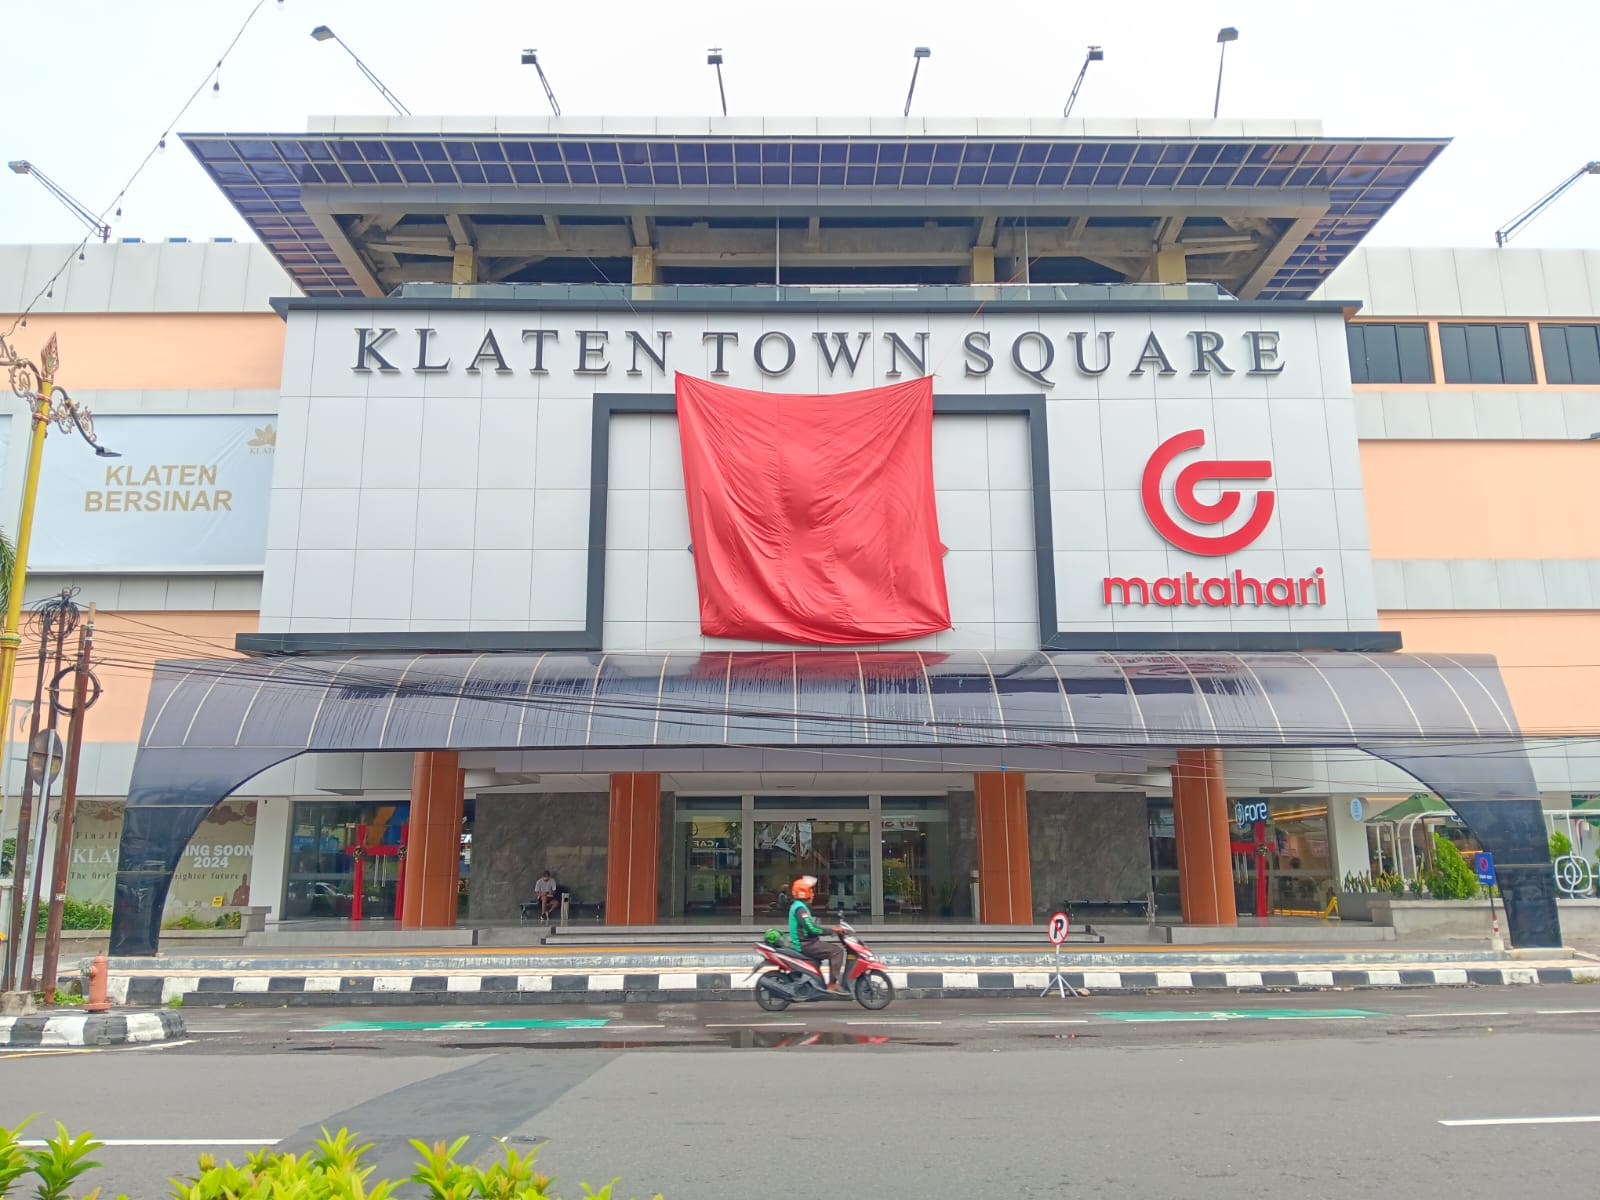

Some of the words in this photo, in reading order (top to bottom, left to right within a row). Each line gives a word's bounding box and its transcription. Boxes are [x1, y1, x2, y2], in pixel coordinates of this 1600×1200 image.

[351, 327, 673, 376] KLATEN
[702, 330, 931, 377] TOWN
[963, 329, 1287, 388] SQUARE
[104, 464, 218, 486] KLATEN
[84, 490, 233, 512] BERSINAR
[1102, 566, 1327, 607] matahari
[213, 844, 255, 857] SOON
[192, 856, 230, 868] 2024
[211, 871, 241, 880] future
